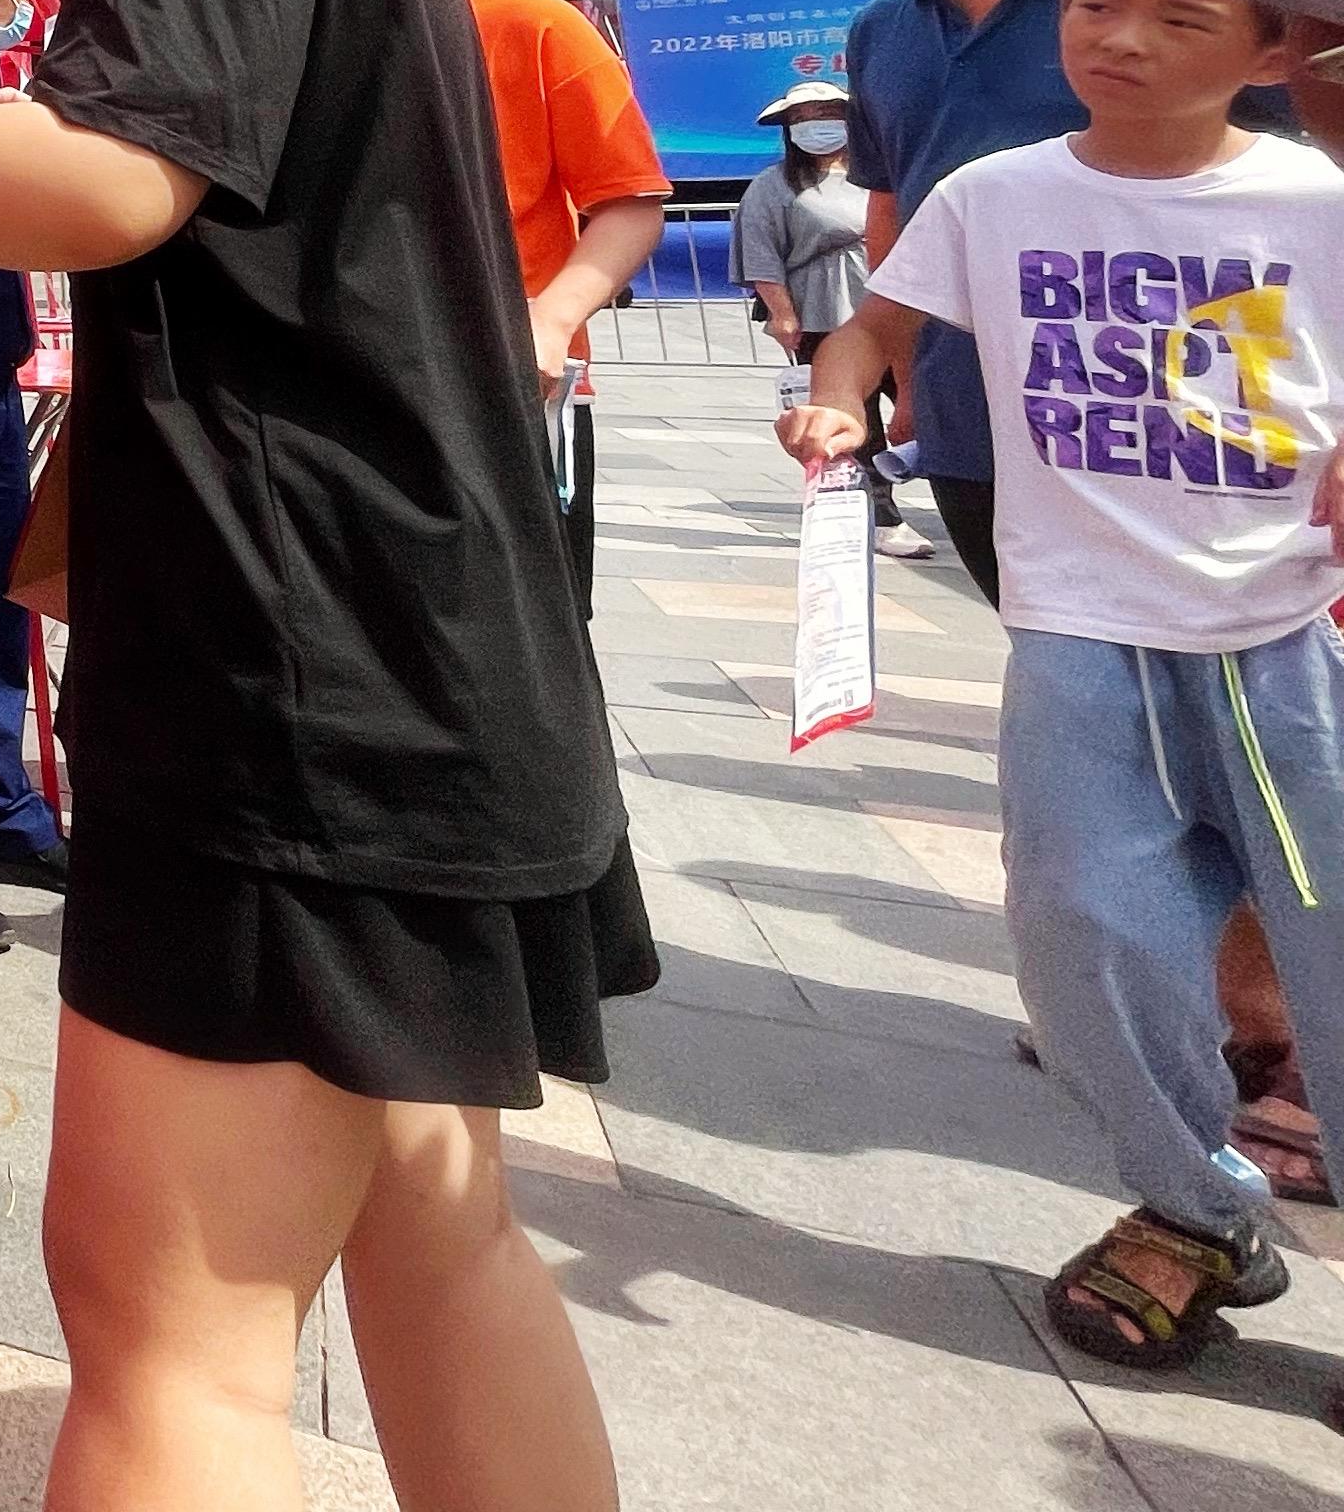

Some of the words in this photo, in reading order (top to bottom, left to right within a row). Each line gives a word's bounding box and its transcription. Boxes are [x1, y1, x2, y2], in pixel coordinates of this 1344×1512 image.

[650, 26, 848, 54] 2022年洛阳市高
